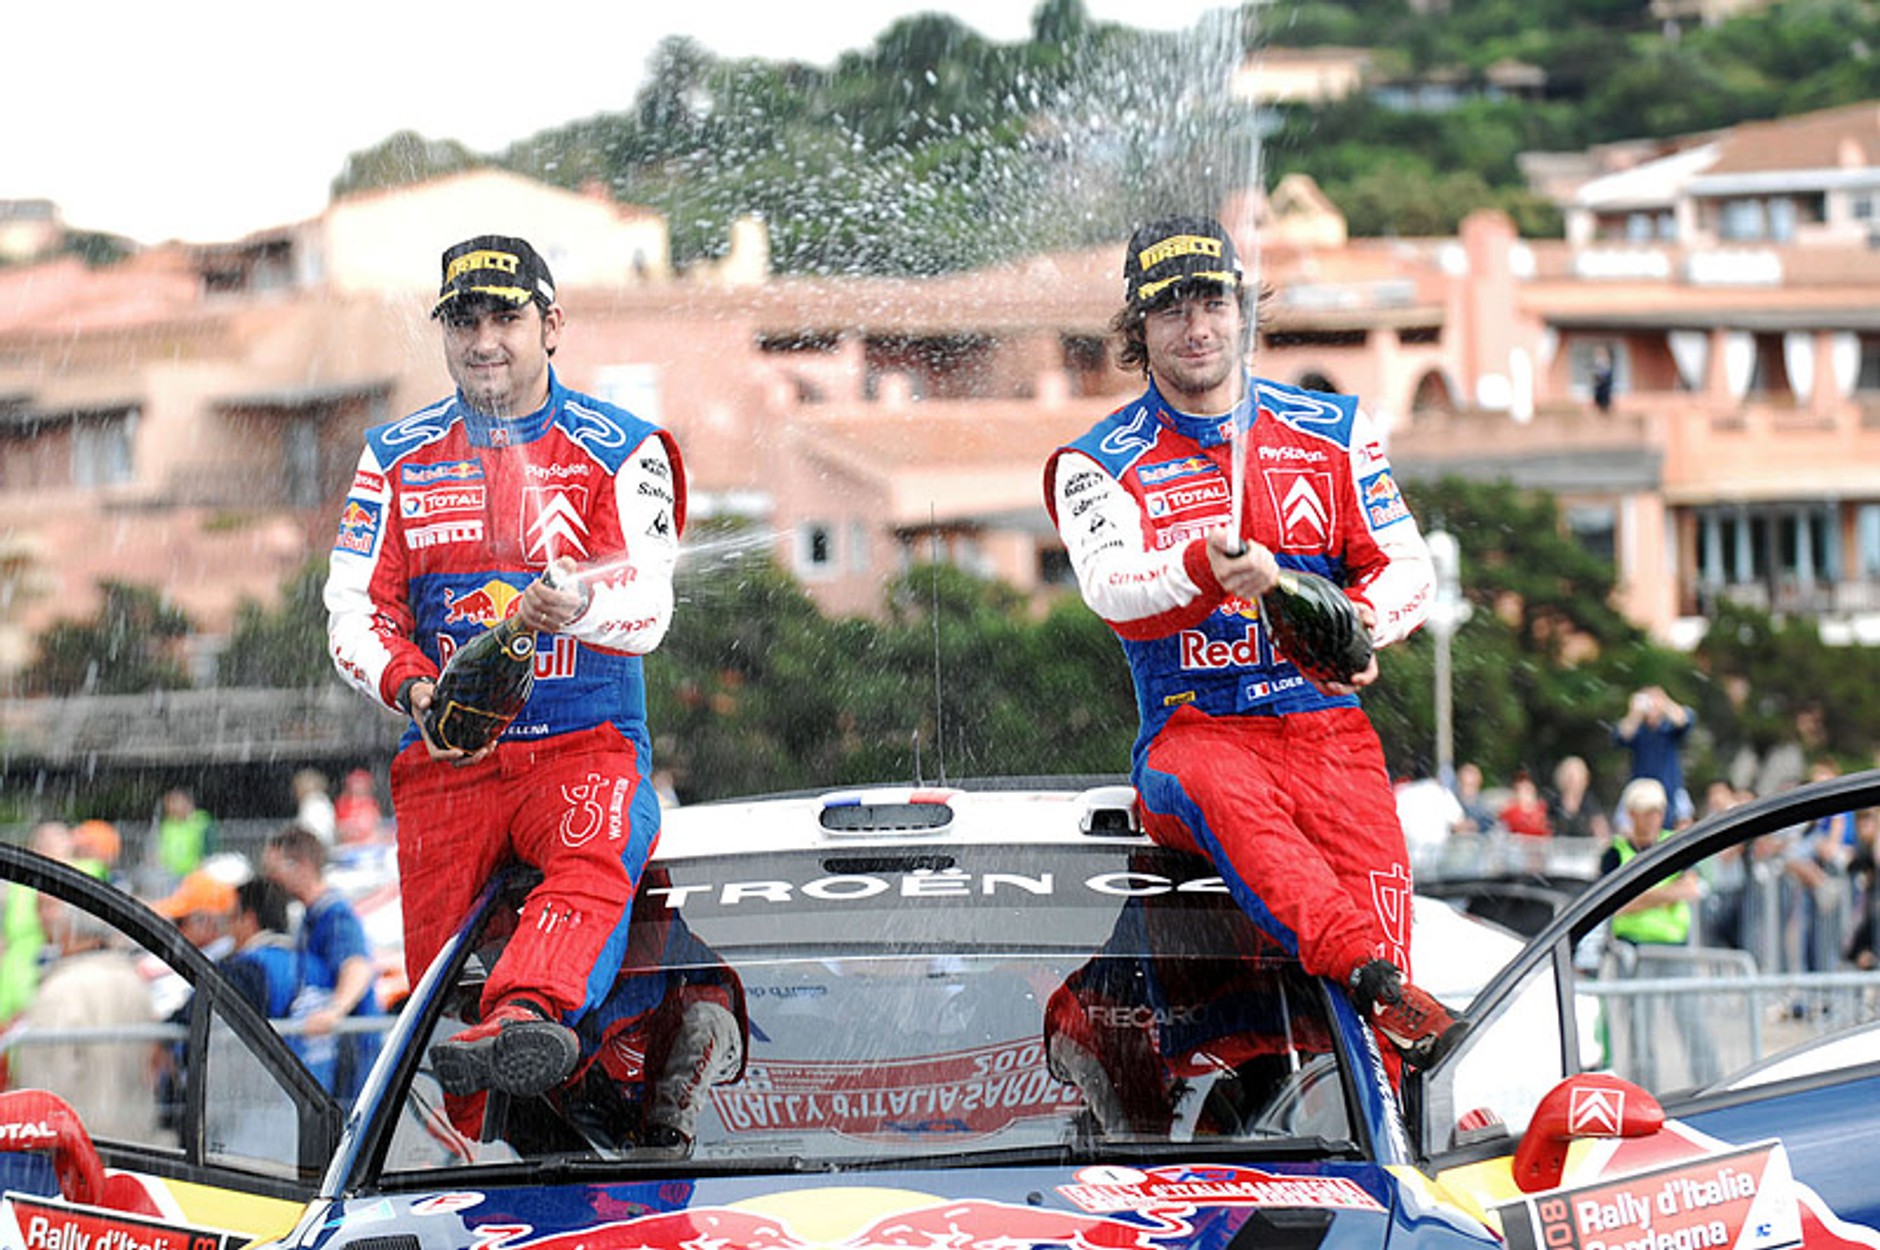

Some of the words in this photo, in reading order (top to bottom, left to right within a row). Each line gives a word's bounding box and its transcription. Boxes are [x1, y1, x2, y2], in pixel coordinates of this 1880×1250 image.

[426, 493, 481, 509] TOTAL
[1168, 486, 1225, 507] TOTAL
[404, 520, 483, 549] PIRELLI
[533, 636, 577, 681] ull
[1180, 622, 1260, 670] Red
[646, 868, 1054, 908] TROËN
[1088, 1003, 1208, 1028] RECARO
[0, 1121, 57, 1140] OTAL
[1576, 1191, 1651, 1235] Rally
[1656, 1167, 1756, 1217] d'Italia
[28, 1216, 90, 1250] Rally
[1585, 1219, 1729, 1250] degna
